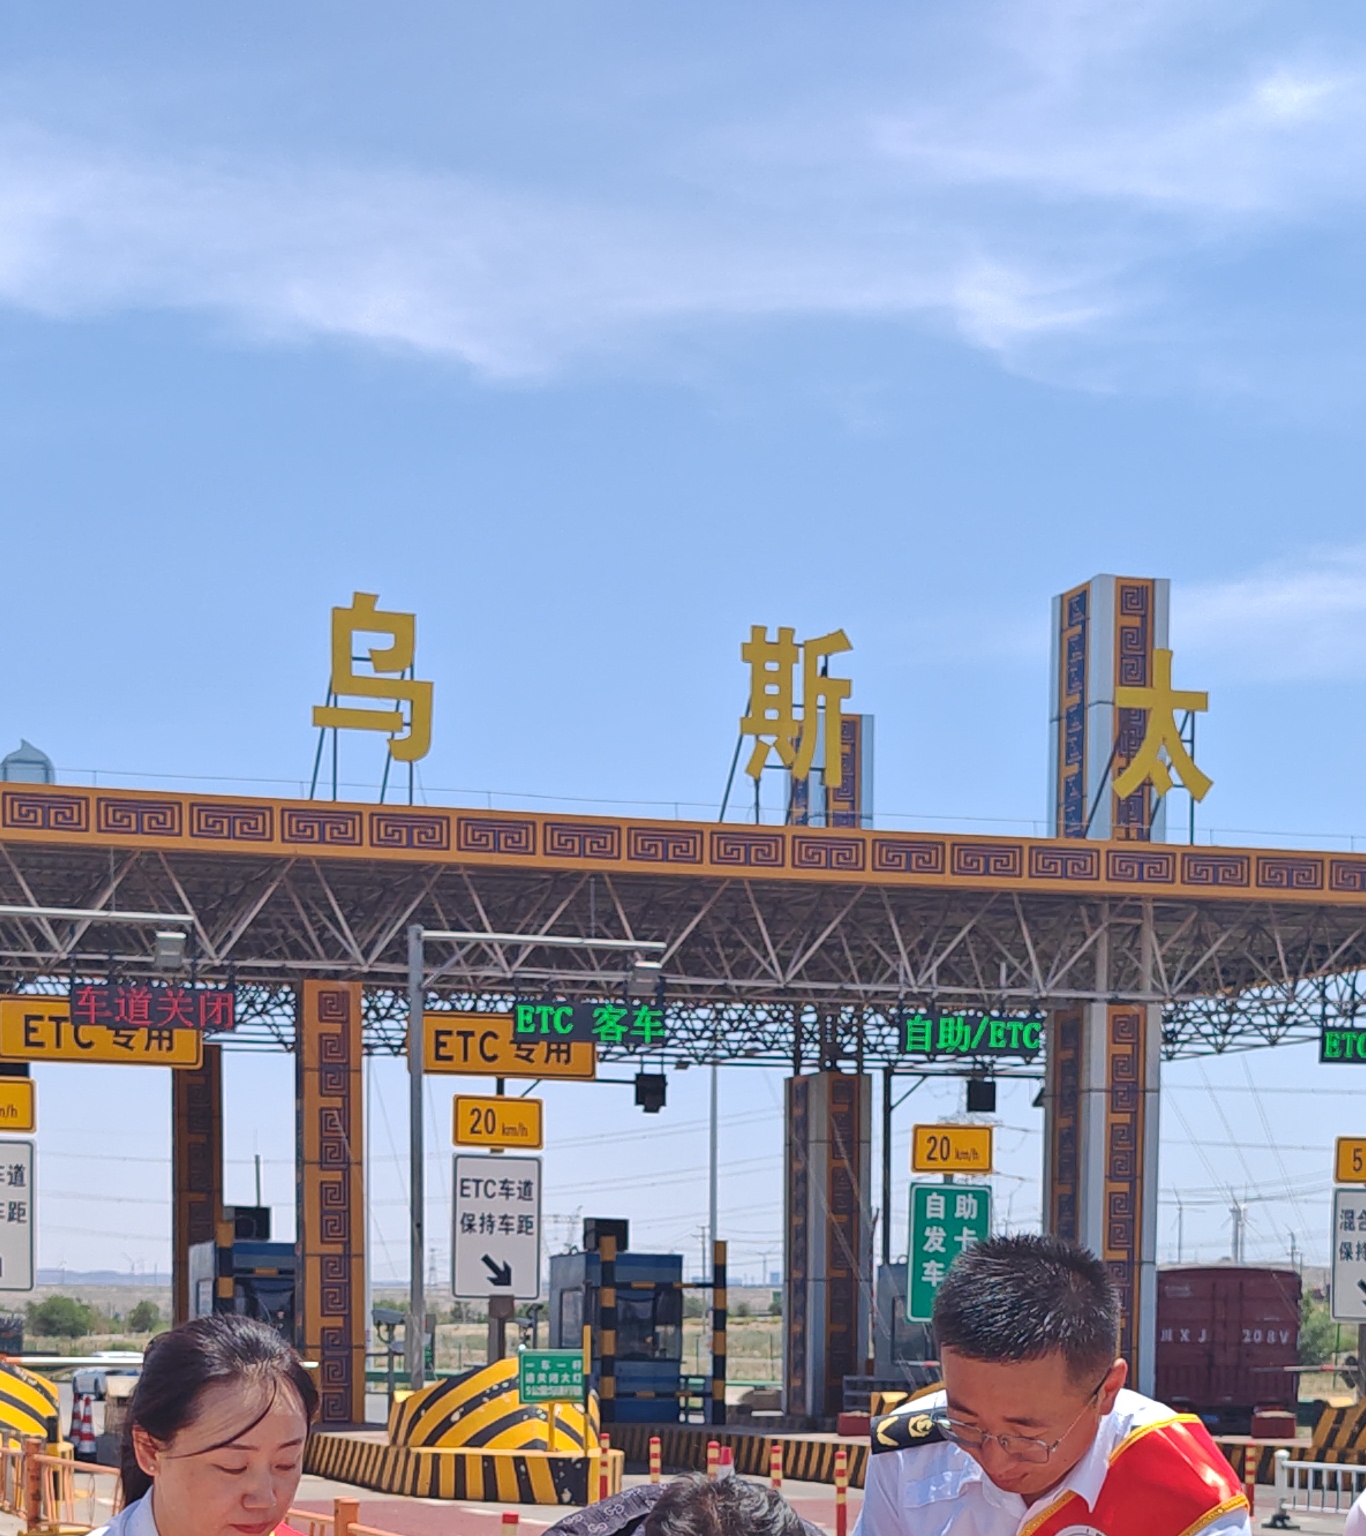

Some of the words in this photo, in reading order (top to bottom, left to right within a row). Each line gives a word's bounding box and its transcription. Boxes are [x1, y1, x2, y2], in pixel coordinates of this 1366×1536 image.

[74, 986, 235, 1029] 车道关闭
[24, 1015, 95, 1050] ETC
[517, 1005, 573, 1035] ETC
[592, 1005, 666, 1044] 客车
[906, 1015, 1042, 1053] 自助/ETC
[434, 1030, 499, 1062] ETC
[470, 1108, 496, 1136] 20
[502, 1122, 528, 1137] km/h
[926, 1136, 950, 1162] 20
[955, 1148, 979, 1162] km/h
[1352, 1148, 1363, 1172] 5
[460, 1178, 534, 1201] ETC车道
[926, 1193, 978, 1220] 自助
[460, 1214, 534, 1236] 保持车距
[923, 1227, 978, 1254] 发卡
